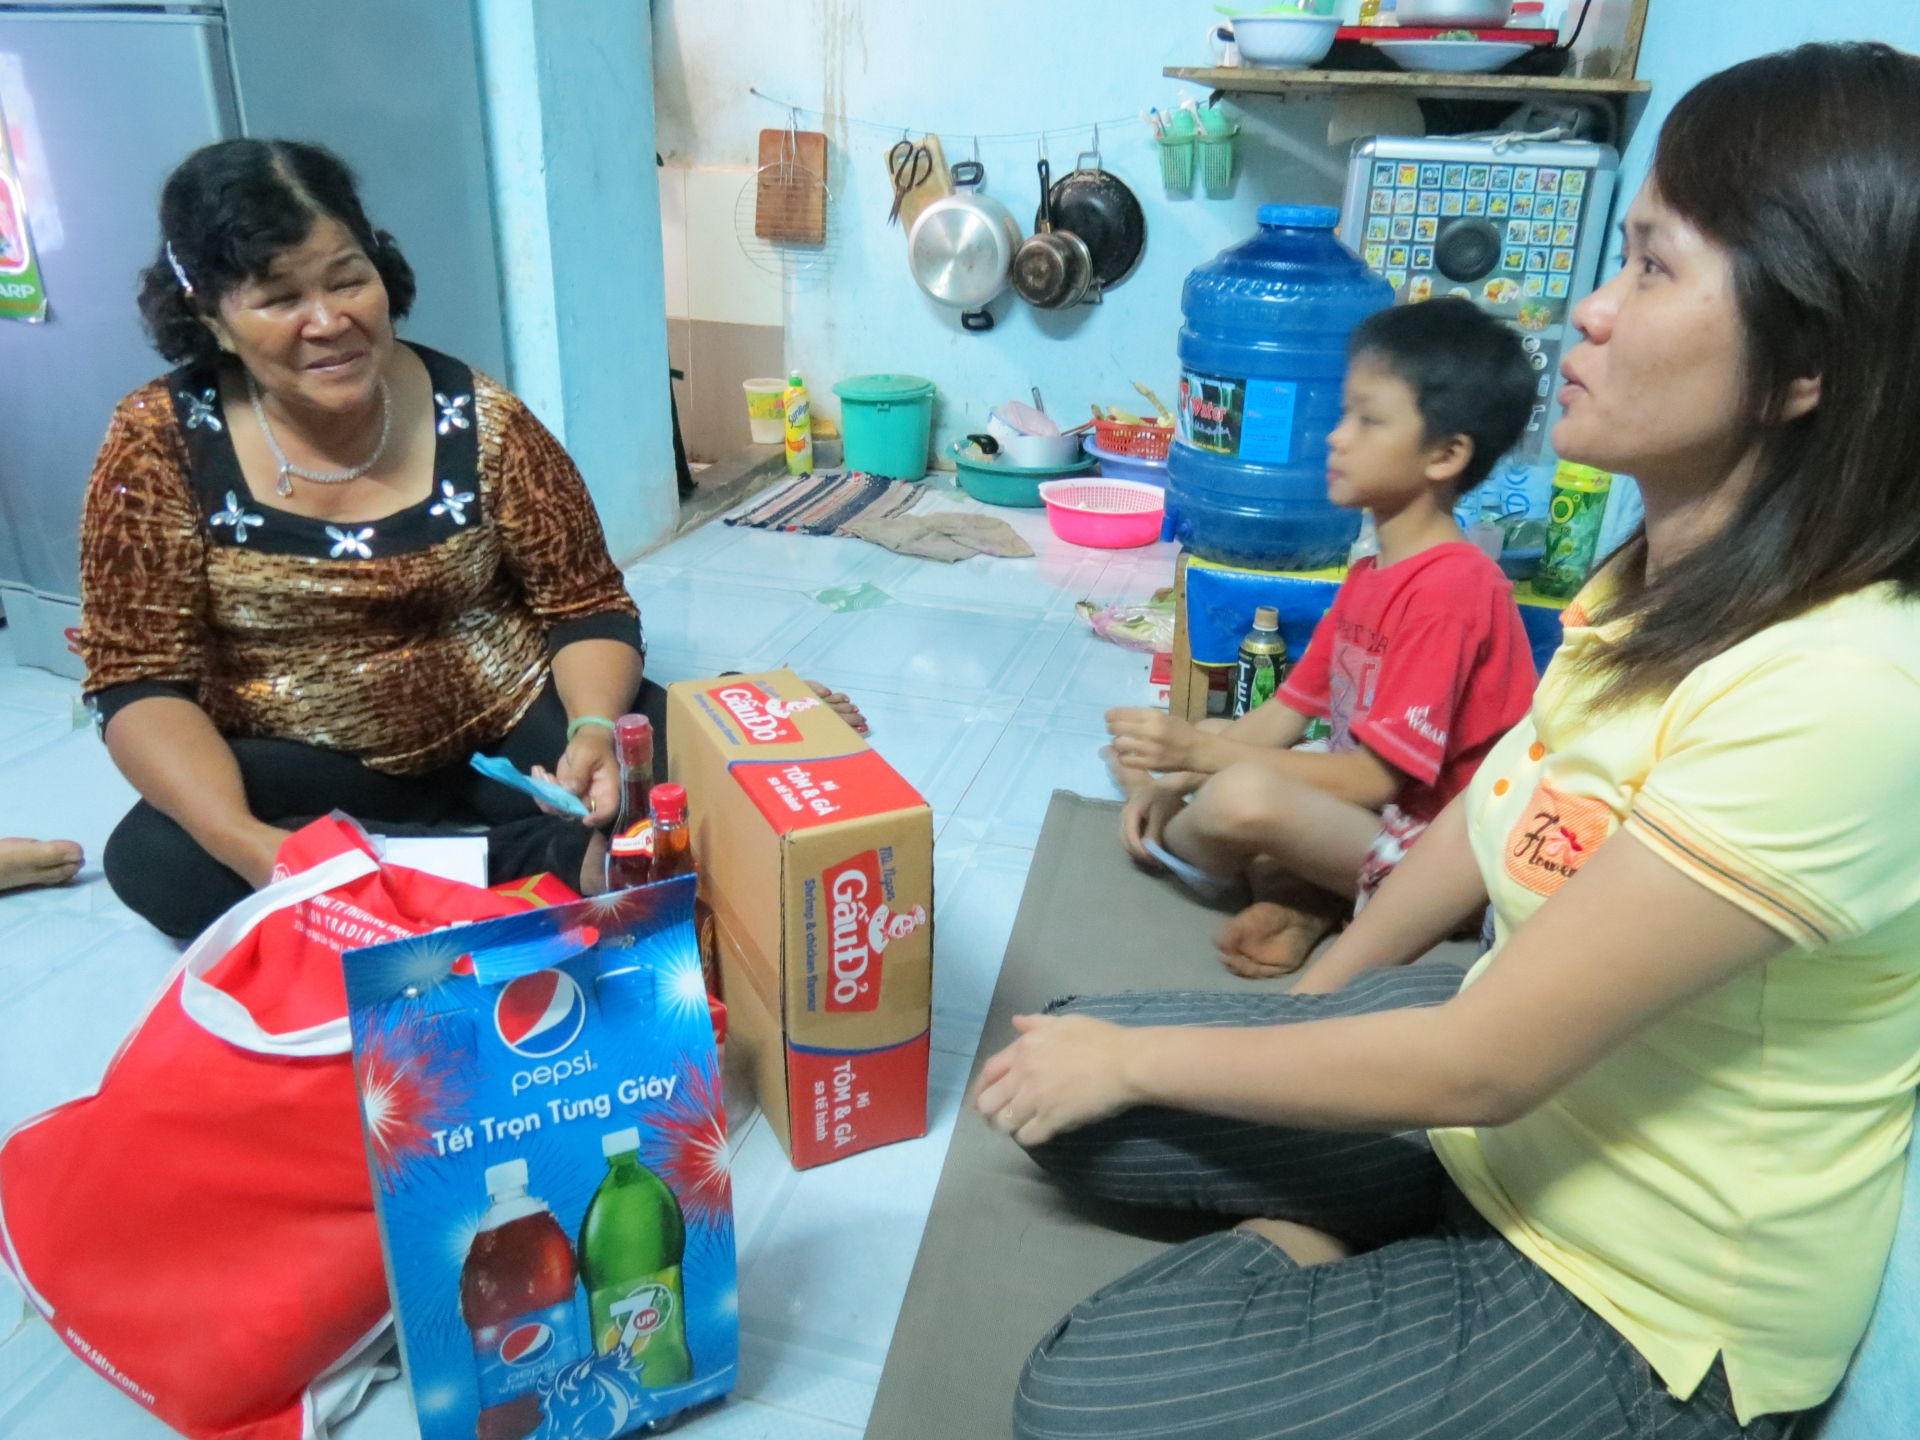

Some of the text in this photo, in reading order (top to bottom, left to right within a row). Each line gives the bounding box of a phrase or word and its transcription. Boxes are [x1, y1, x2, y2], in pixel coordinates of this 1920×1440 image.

[1234, 660, 1251, 717] TEA
[782, 765, 841, 817] TÔM & GÀ
[325, 915, 387, 945] TRADING
[806, 922, 816, 930] &
[511, 1050, 592, 1096] pepsi
[814, 1080, 825, 1095] sa
[432, 1128, 474, 1157] Tết
[480, 1112, 541, 1144] Trọn
[547, 1092, 611, 1124] Từng
[833, 1060, 857, 1148] TÔM & GÀ
[635, 1311, 656, 1326] UP
